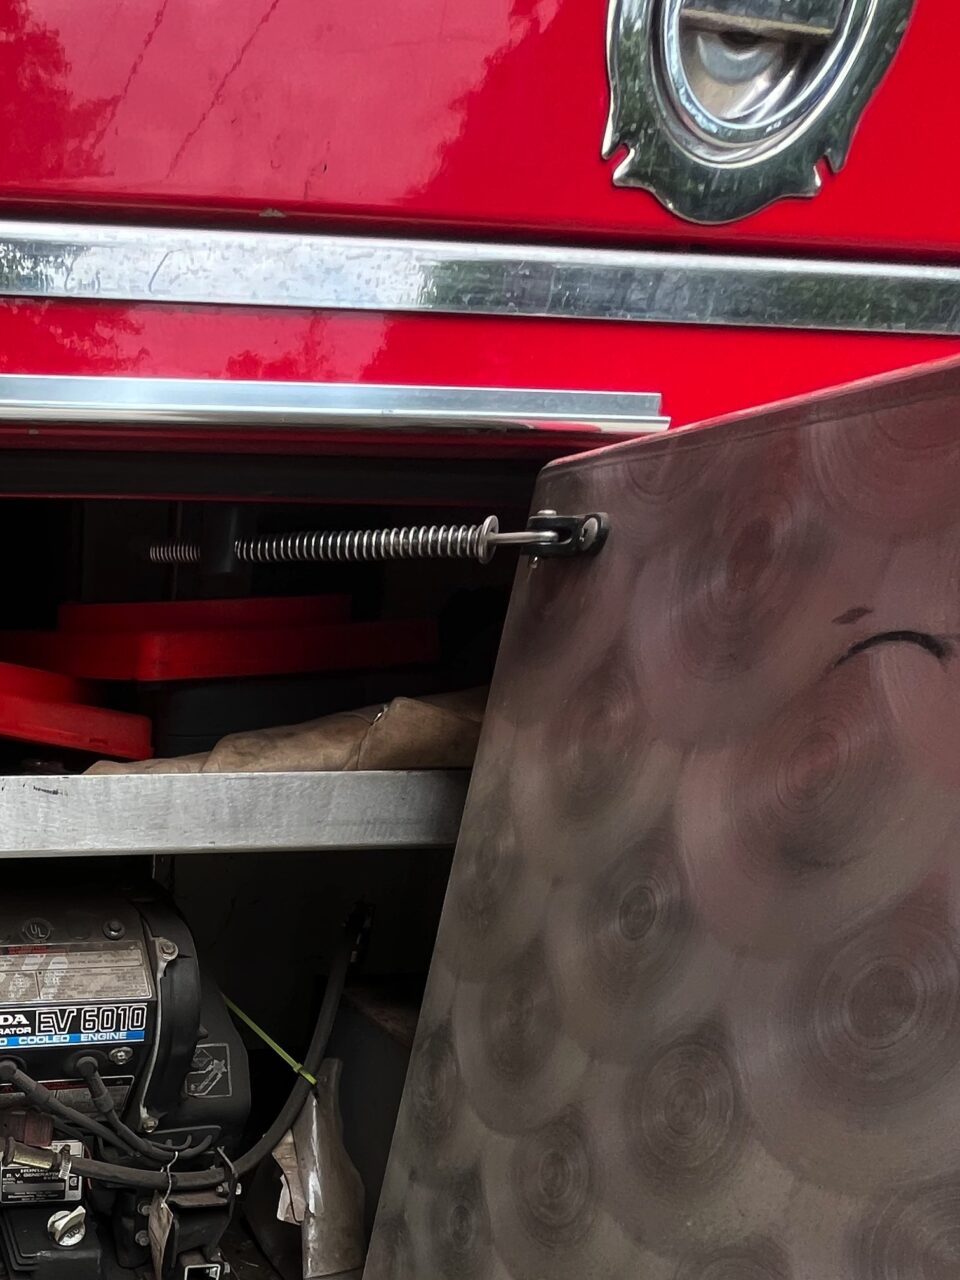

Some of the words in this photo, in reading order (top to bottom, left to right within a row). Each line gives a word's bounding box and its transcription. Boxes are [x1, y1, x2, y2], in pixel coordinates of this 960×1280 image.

[36, 1008, 77, 1036] EV
[81, 1006, 147, 1033] 6010
[18, 1034, 70, 1045] COOLED
[80, 1032, 126, 1042] ENGINE
